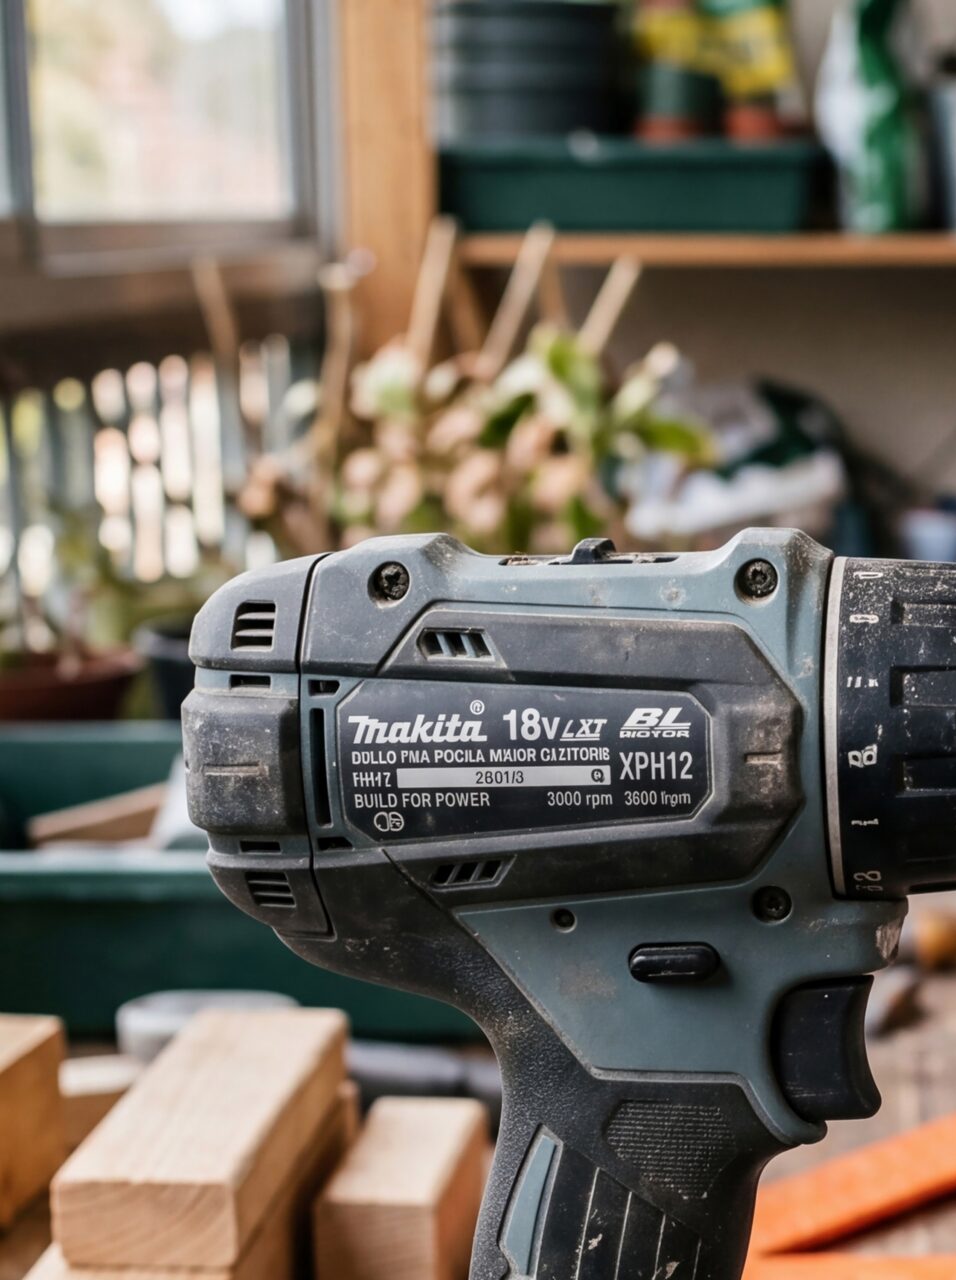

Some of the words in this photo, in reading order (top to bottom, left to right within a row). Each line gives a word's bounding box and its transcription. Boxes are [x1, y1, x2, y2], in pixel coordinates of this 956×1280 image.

[621, 707, 692, 728] BL
[560, 718, 608, 741] LXT
[434, 749, 485, 763] POCILA
[619, 751, 693, 780] XPH12
[354, 793, 398, 808] BUILD
[402, 792, 432, 808] FOR
[435, 792, 491, 807] POWER
[547, 791, 582, 806] 3000
[586, 793, 613, 809] rpm
[624, 791, 658, 806] 3600
